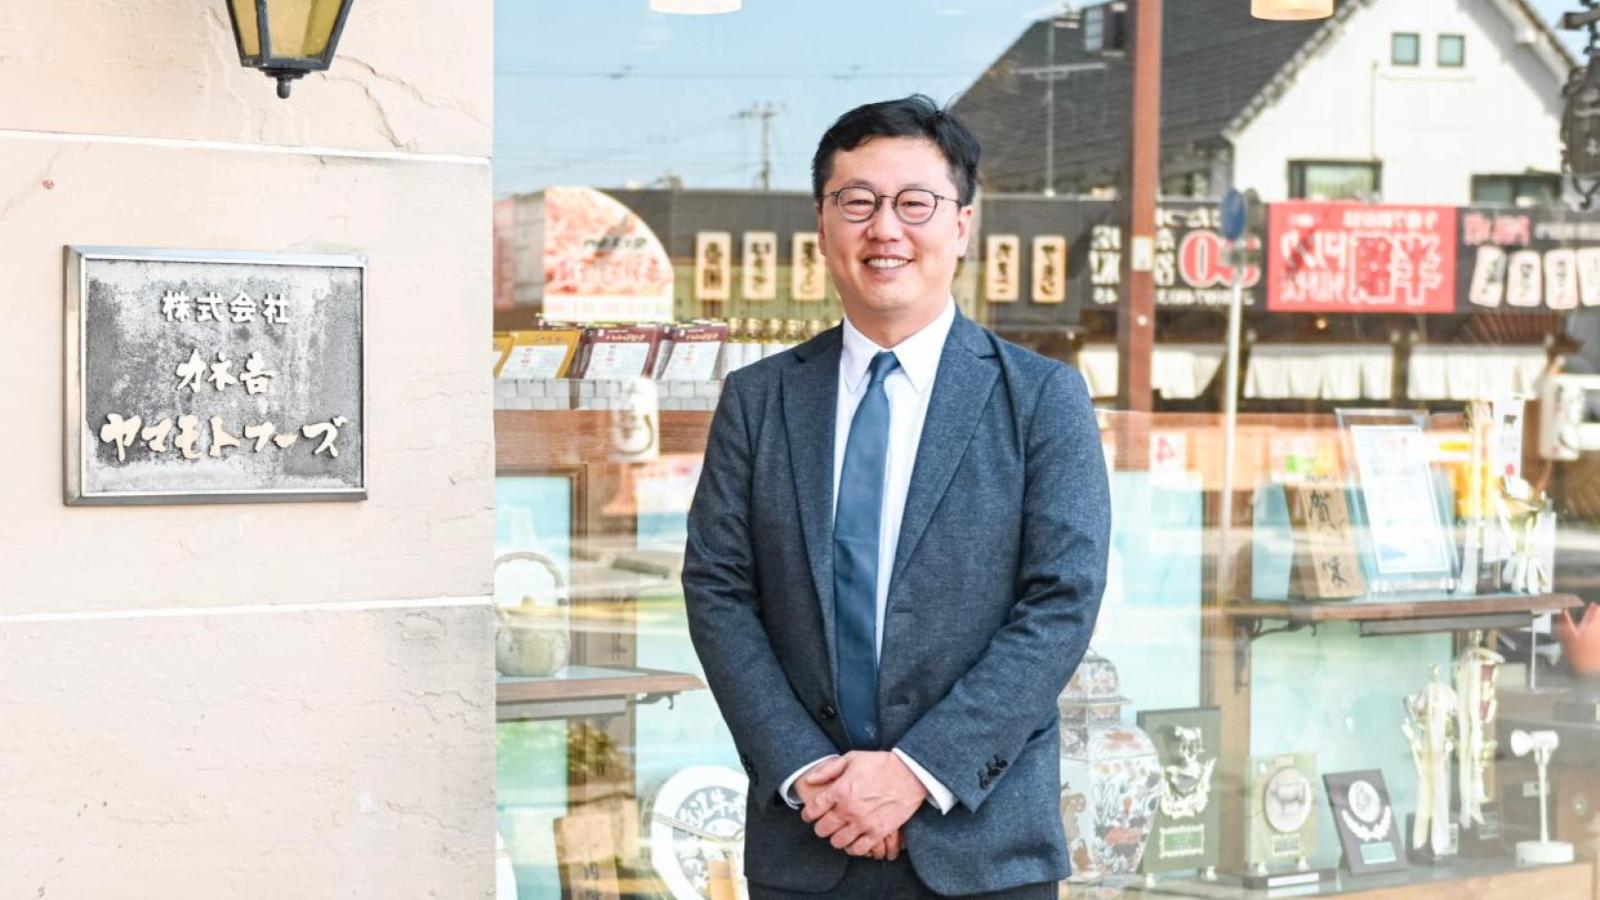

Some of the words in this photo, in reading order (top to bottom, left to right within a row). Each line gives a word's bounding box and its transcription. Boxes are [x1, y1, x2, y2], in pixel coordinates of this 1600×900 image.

[162, 291, 290, 323] 株式会社
[177, 348, 277, 394] カネ吉
[100, 413, 347, 462] ヤマモトフーズ
